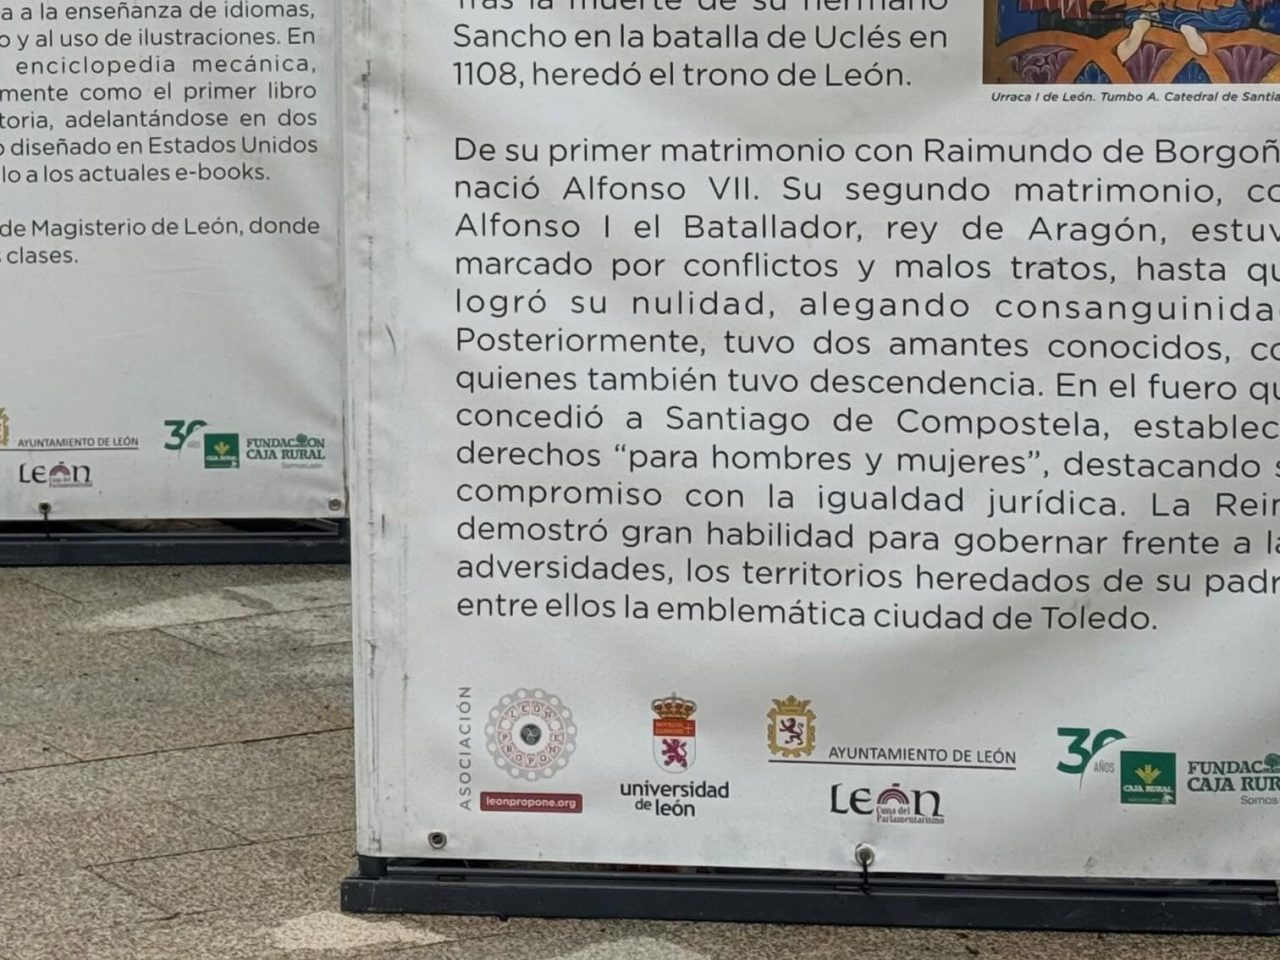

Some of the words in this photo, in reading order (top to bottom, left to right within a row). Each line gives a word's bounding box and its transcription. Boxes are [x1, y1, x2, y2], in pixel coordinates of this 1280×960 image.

[991, 92, 1032, 102] Urraca
[1035, 92, 1040, 102] I
[1042, 91, 1059, 102] de
[1062, 91, 1096, 102] León.
[1100, 91, 1143, 102] Tumbo
[1146, 91, 1159, 102] A.
[1164, 91, 1219, 102] Catedral
[1221, 91, 1238, 102] de
[6, 245, 78, 264] clases.
[17, 437, 95, 448] AYUNTAMIENTO
[97, 436, 110, 446] DE
[112, 435, 139, 446] LEÓN
[246, 449, 278, 460] CAJA
[281, 449, 326, 460] RURAL
[457, 593, 538, 617] entre
[545, 592, 616, 618] ellos
[624, 593, 648, 619] la
[657, 595, 865, 627] emblemática
[873, 602, 983, 630] ciudad
[992, 605, 1032, 630] de
[1040, 604, 1157, 630] Toledo.
[456, 687, 471, 811] ASOCIACIÓN
[828, 746, 948, 762] AYUNTAMIENTO
[952, 748, 972, 763] DE
[976, 747, 1016, 764] LEÓN
[1094, 760, 1115, 773] AÑOS
[620, 779, 730, 799] universidad
[1187, 777, 1236, 793] CAJA
[1240, 776, 1280, 792] RUR
[486, 796, 577, 810] leonpropone.org
[635, 798, 652, 810] de
[655, 798, 695, 817] león
[898, 806, 911, 815] del
